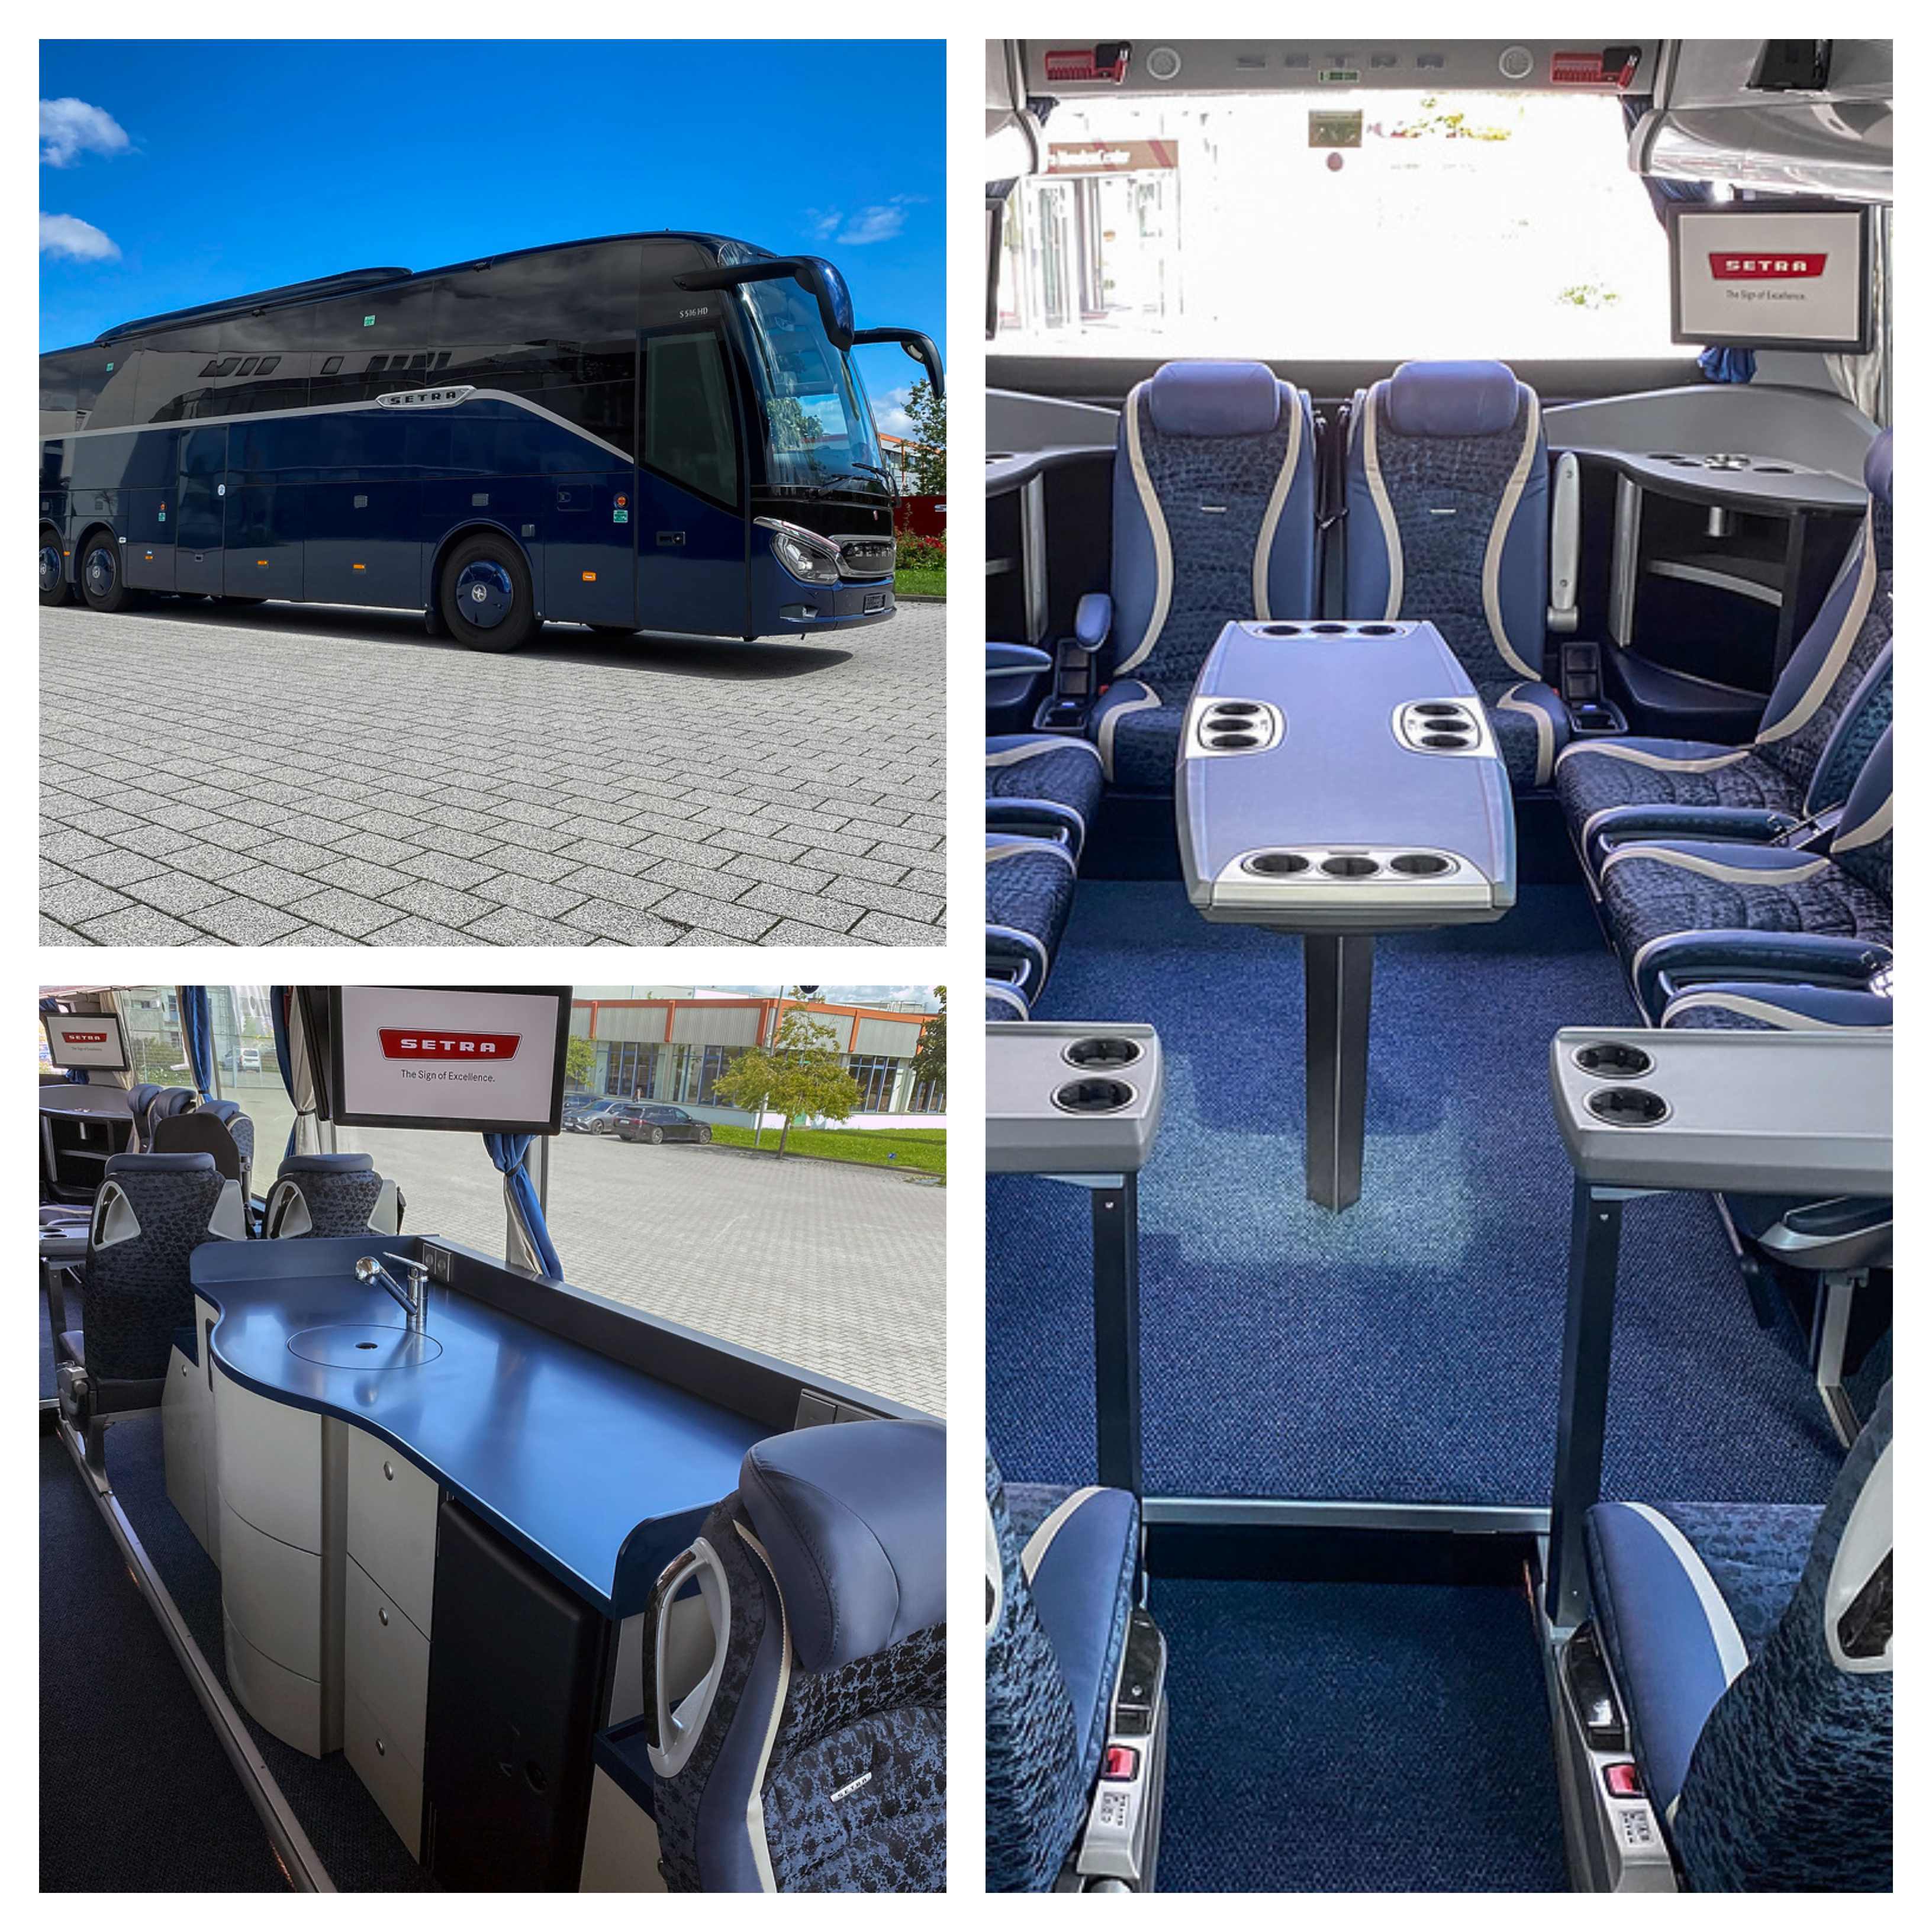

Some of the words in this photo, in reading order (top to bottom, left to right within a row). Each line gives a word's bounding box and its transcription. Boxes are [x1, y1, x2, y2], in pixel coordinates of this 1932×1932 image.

[1725, 260, 1807, 272] SETRA
[697, 307, 708, 315] HD
[389, 391, 456, 405] SETRA
[400, 1039, 496, 1053] SETRA
[401, 1069, 417, 1079] The
[418, 1070, 437, 1082] Sign
[437, 1070, 446, 1080] of
[448, 1071, 495, 1083] Excellence.
[837, 1778, 867, 1798] SETRA
